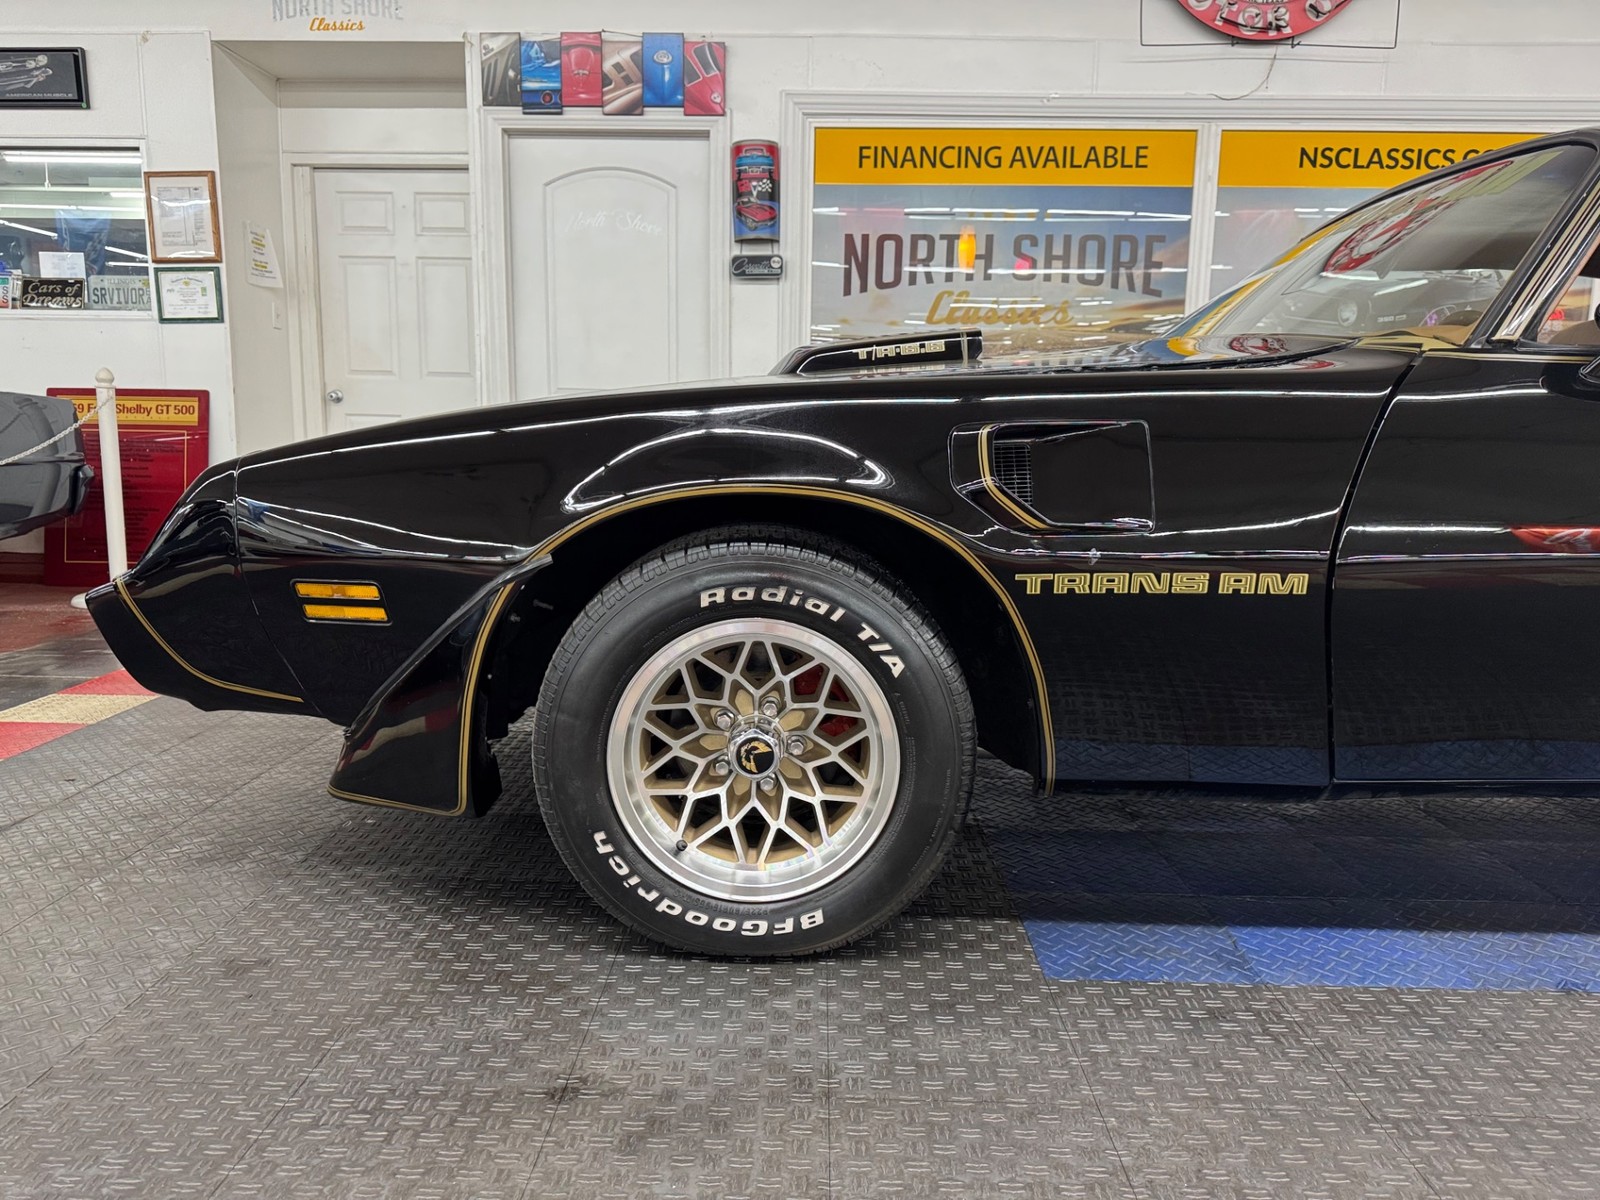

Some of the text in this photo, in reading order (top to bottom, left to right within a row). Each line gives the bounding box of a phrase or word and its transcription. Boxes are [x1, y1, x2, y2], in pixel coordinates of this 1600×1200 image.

[309, 17, 366, 31] Classics
[857, 145, 1149, 169] FINANCING AVAILABLE
[843, 233, 1167, 298] NORTH SHORE
[28, 282, 81, 295] Cars of
[92, 287, 146, 305] SRVIVOR
[22, 293, 83, 306] Dreams
[925, 290, 1074, 326] Classics
[116, 403, 153, 416] Shelby
[155, 404, 172, 415] GT
[173, 404, 195, 415] 500
[1014, 572, 1310, 595] TRANS AM
[700, 585, 847, 623] Radial
[856, 621, 906, 679] T/A
